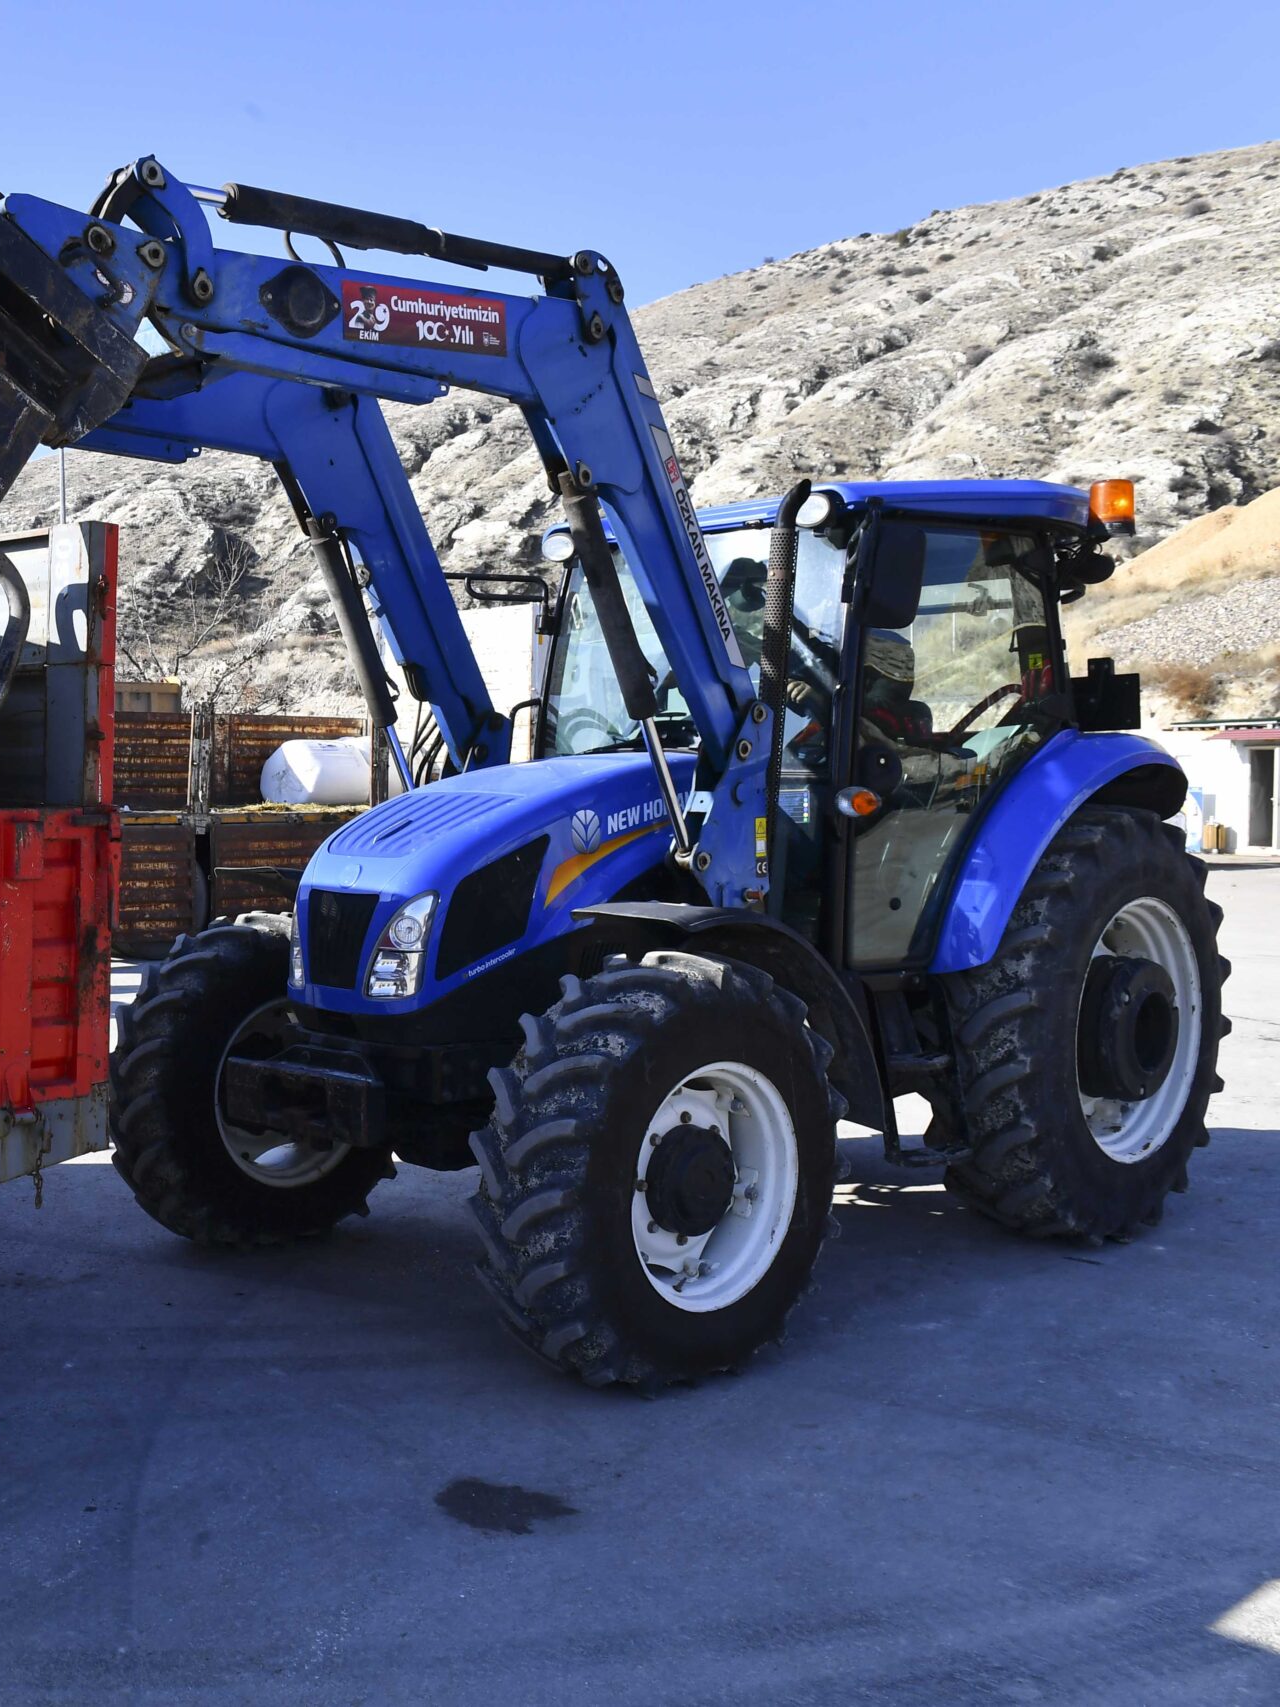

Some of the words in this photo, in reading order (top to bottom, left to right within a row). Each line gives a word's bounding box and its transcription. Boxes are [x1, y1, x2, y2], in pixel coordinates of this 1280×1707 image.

[390, 296, 500, 324] Cumhuriyetimizin
[359, 329, 380, 342] EKİM
[675, 487, 703, 560] ÖZKAN
[700, 562, 731, 642] MAKİNA
[607, 805, 641, 835] NEW
[468, 964, 486, 977] turbo
[485, 948, 516, 969] intercooler
